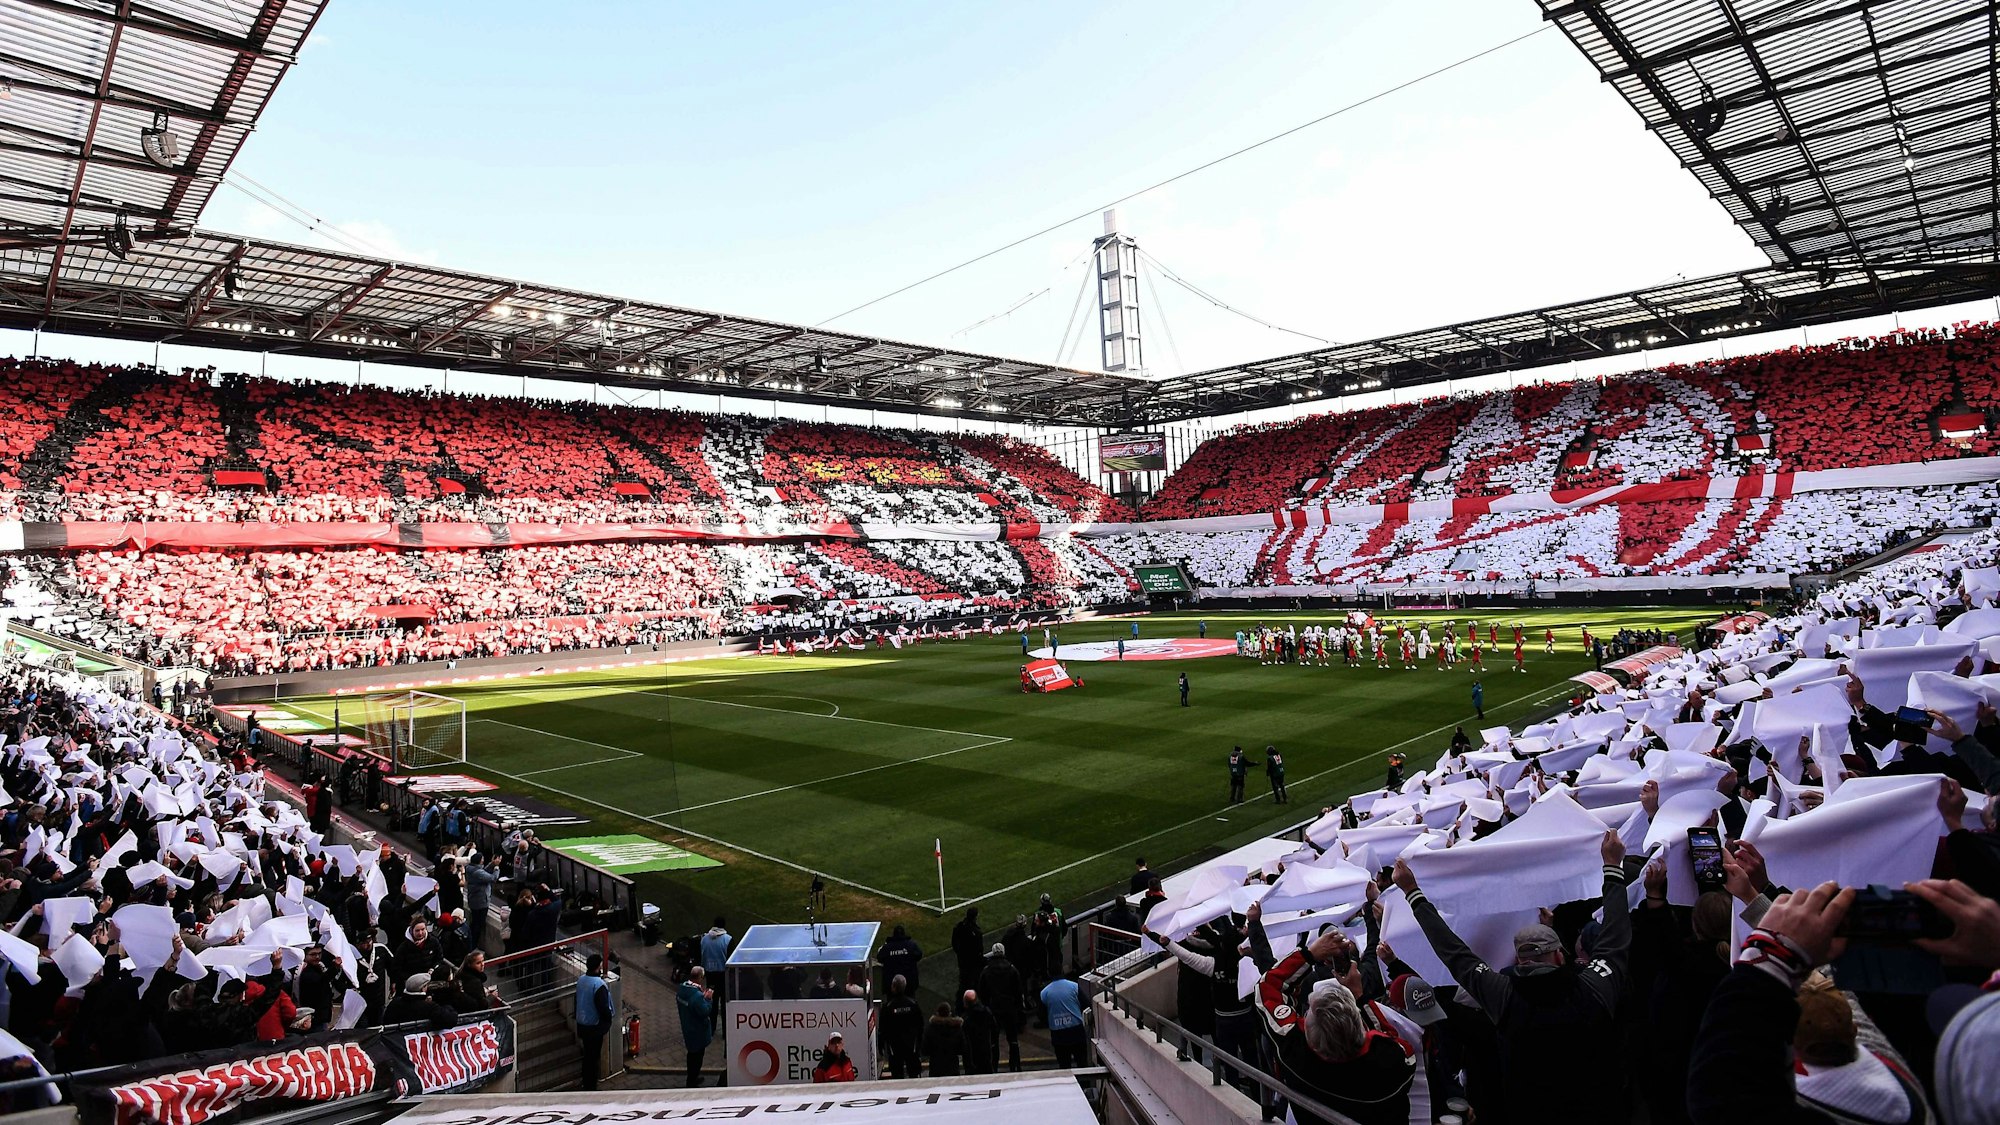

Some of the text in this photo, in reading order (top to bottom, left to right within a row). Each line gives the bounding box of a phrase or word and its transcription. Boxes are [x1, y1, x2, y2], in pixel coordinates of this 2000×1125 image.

[736, 1011, 858, 1030] POWERBANK
[404, 1020, 499, 1094] MATTES
[787, 1045, 825, 1062] Rhe
[446, 1089, 1002, 1125] RheinEnergie
